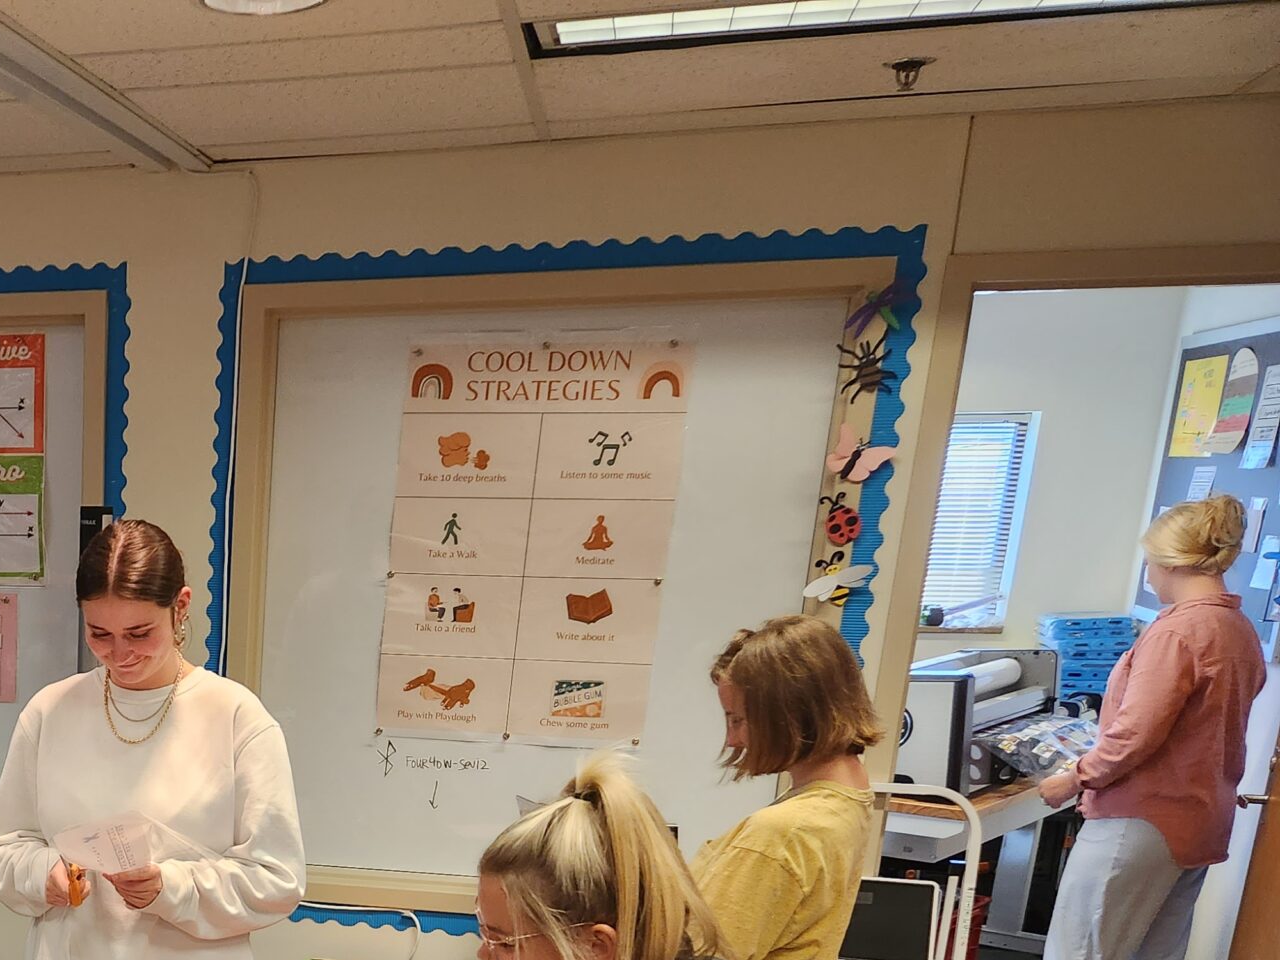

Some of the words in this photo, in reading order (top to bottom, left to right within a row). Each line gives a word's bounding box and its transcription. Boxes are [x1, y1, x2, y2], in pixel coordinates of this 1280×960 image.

[467, 350, 539, 372] COOL
[547, 350, 632, 372] DOWN
[465, 379, 620, 401] STRATEGIES
[418, 473, 438, 482] Take
[453, 474, 474, 484] deep
[476, 474, 507, 482] breaths
[560, 471, 586, 480] Listen
[626, 471, 652, 480] music
[427, 549, 447, 559] Take
[456, 550, 478, 559] Walk
[575, 556, 615, 565] Meditate
[415, 623, 433, 633] Talk
[434, 624, 443, 632] to
[452, 624, 476, 634] friend
[556, 632, 580, 641] Write
[582, 632, 606, 642] about
[608, 633, 615, 642] it
[554, 694, 582, 707] BUBBLE
[584, 690, 602, 700] GUM
[397, 710, 413, 722] Play
[415, 710, 433, 720] with
[435, 712, 477, 723] Playdough
[540, 719, 564, 729] Chew
[590, 722, 609, 731] gum
